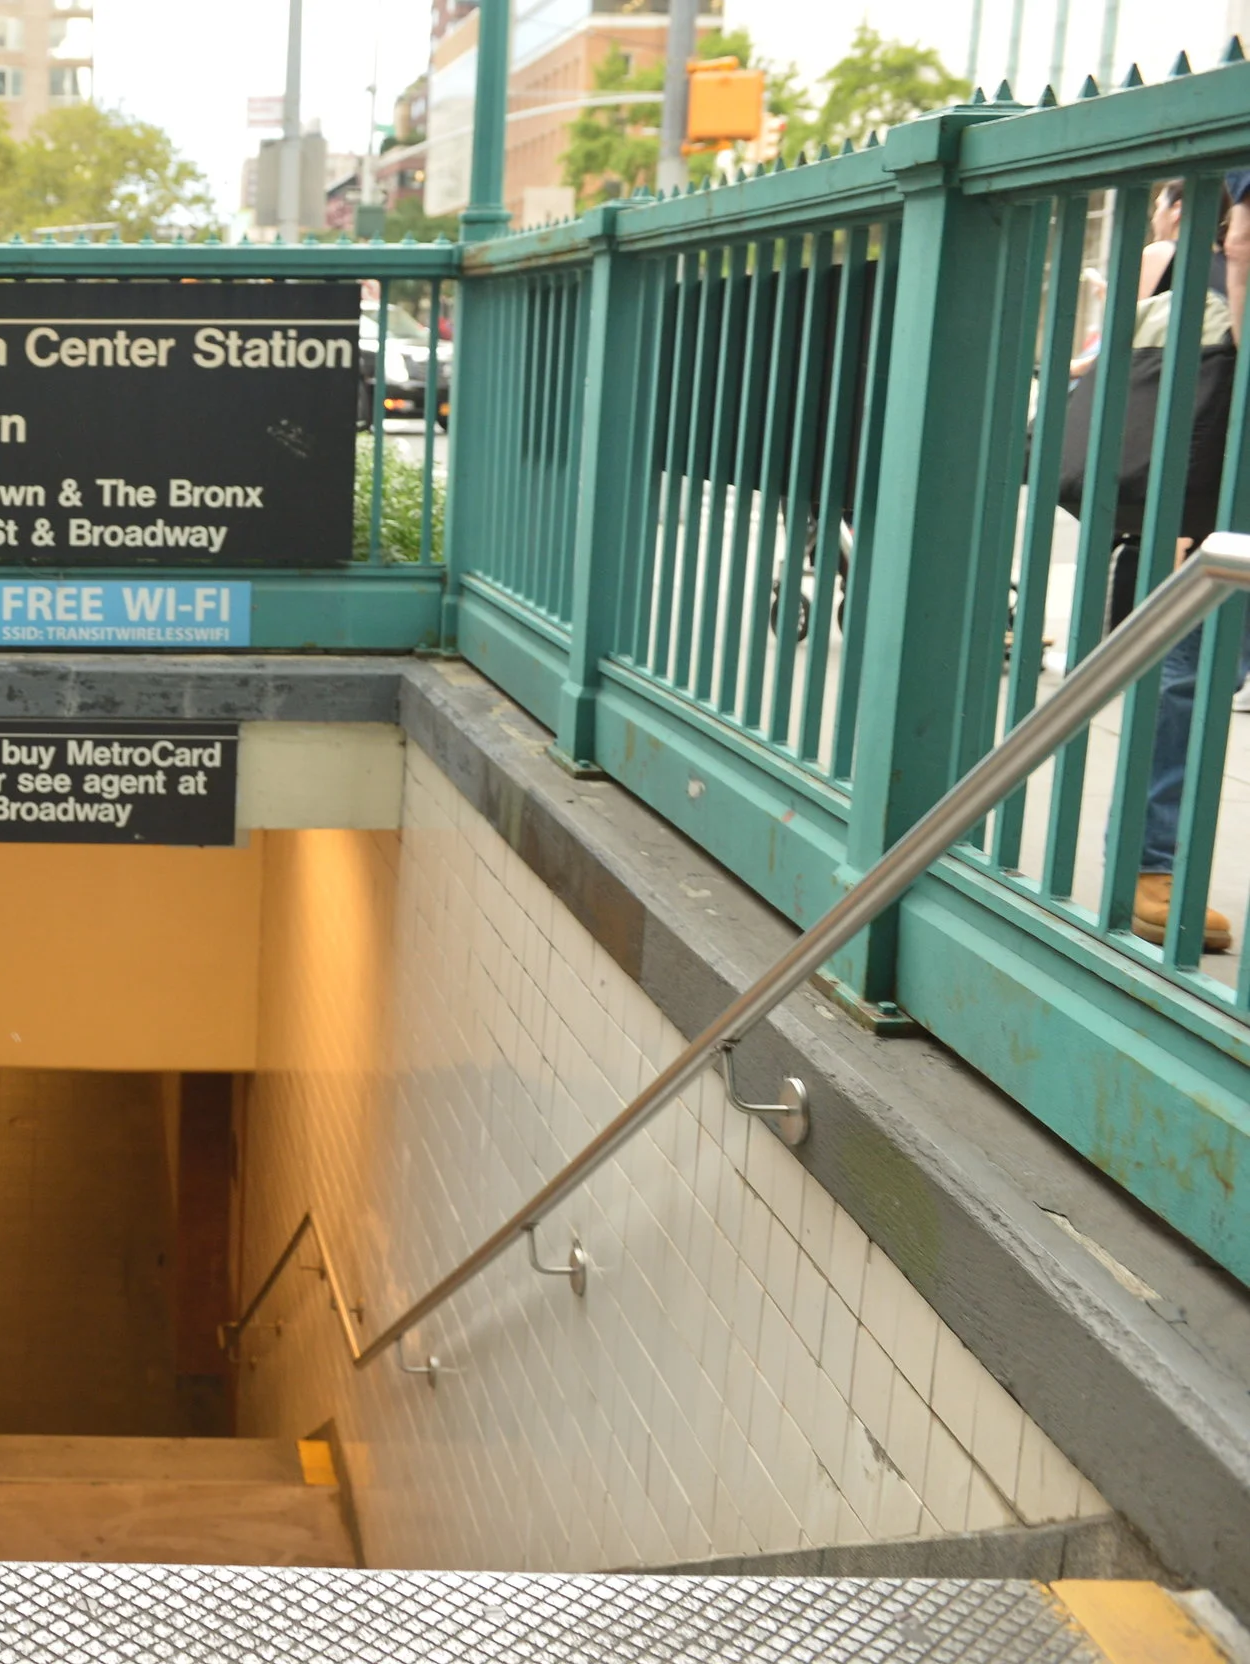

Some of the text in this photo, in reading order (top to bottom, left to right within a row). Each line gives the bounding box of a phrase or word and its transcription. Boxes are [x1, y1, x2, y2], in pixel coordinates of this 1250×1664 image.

[25, 327, 175, 368] Center
[192, 328, 353, 369] Station
[59, 479, 82, 508] &
[96, 478, 157, 508] The
[169, 479, 264, 508] Bronx
[32, 518, 55, 547] &
[70, 518, 227, 553] Broadway
[3, 586, 229, 621] FREE WI-FI
[2, 626, 229, 642] SSID: TRANSITWIRELESSWIFI
[1, 738, 55, 772] buy
[67, 741, 221, 768] MetroCard
[18, 773, 71, 794] see
[83, 770, 166, 797] agent
[178, 770, 207, 795] at
